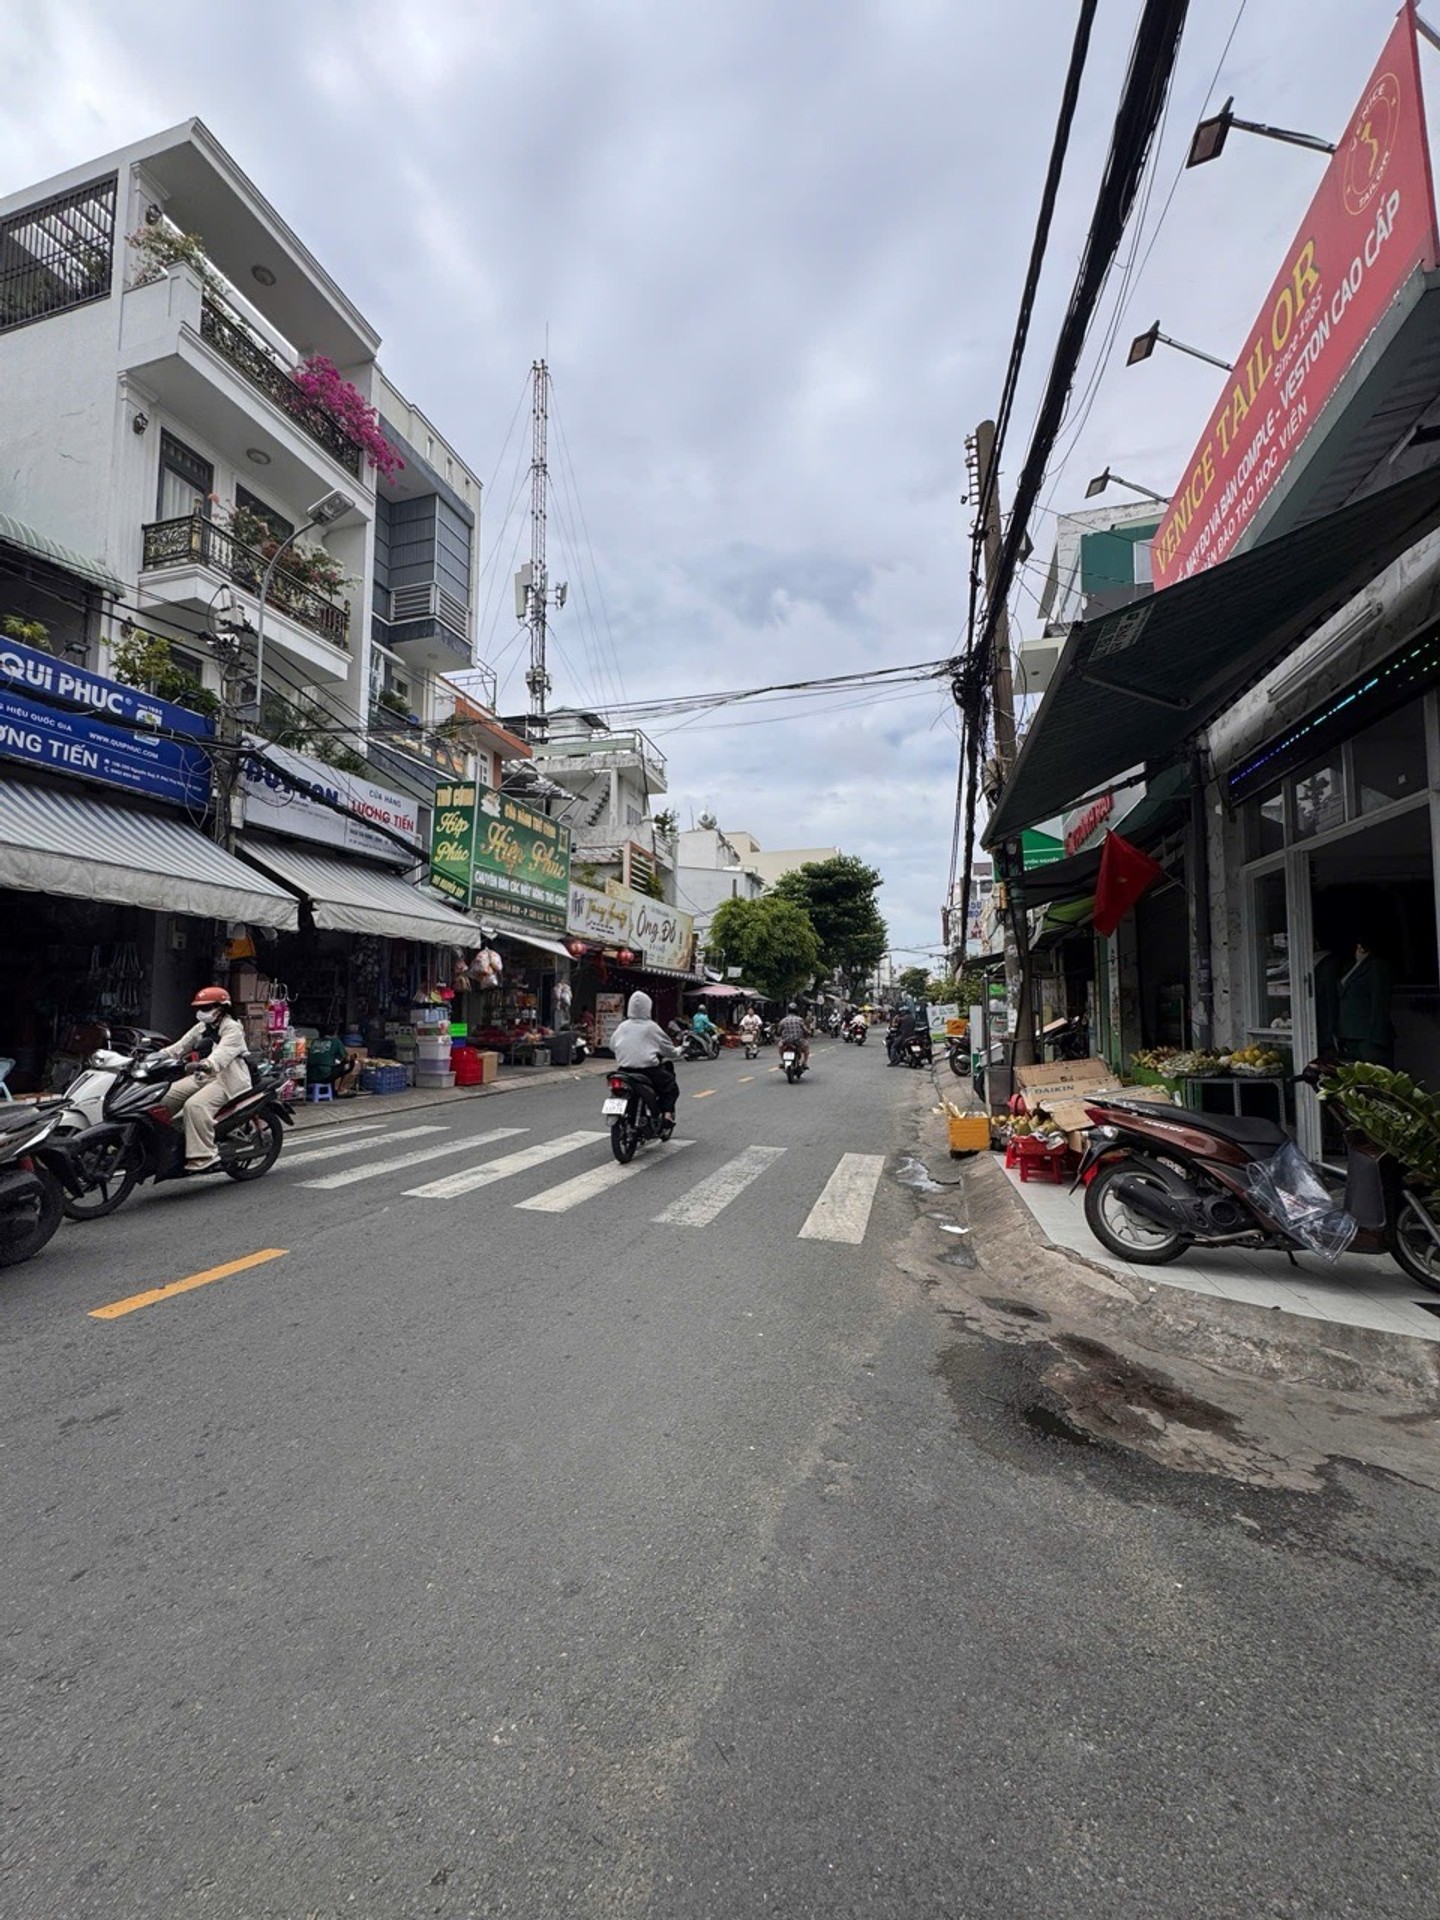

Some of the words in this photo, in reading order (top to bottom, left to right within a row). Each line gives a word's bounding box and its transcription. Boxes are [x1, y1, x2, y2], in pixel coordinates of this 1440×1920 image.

[1237, 408, 1275, 489] COMPLE
[1280, 319, 1331, 412] VESTON
[1330, 258, 1364, 328] CAO
[1362, 188, 1402, 280] CẤP
[1156, 441, 1216, 576] VENICE
[1216, 237, 1322, 459] TAILOR
[1218, 520, 1236, 556] ĐÀO
[1235, 486, 1255, 523] TẠO
[1255, 446, 1278, 492] HỌC
[1279, 396, 1308, 450] VIÊN
[0, 652, 53, 690] QUI
[58, 673, 124, 714] PHUC
[5, 704, 29, 718] HIỆU
[29, 712, 56, 727] QUỐC
[57, 721, 73, 732] GIA
[48, 738, 99, 770] TIẾN
[394, 814, 414, 831] TIẾN
[636, 904, 660, 944] Ông
[1034, 1084, 1075, 1095] DAIKIN
